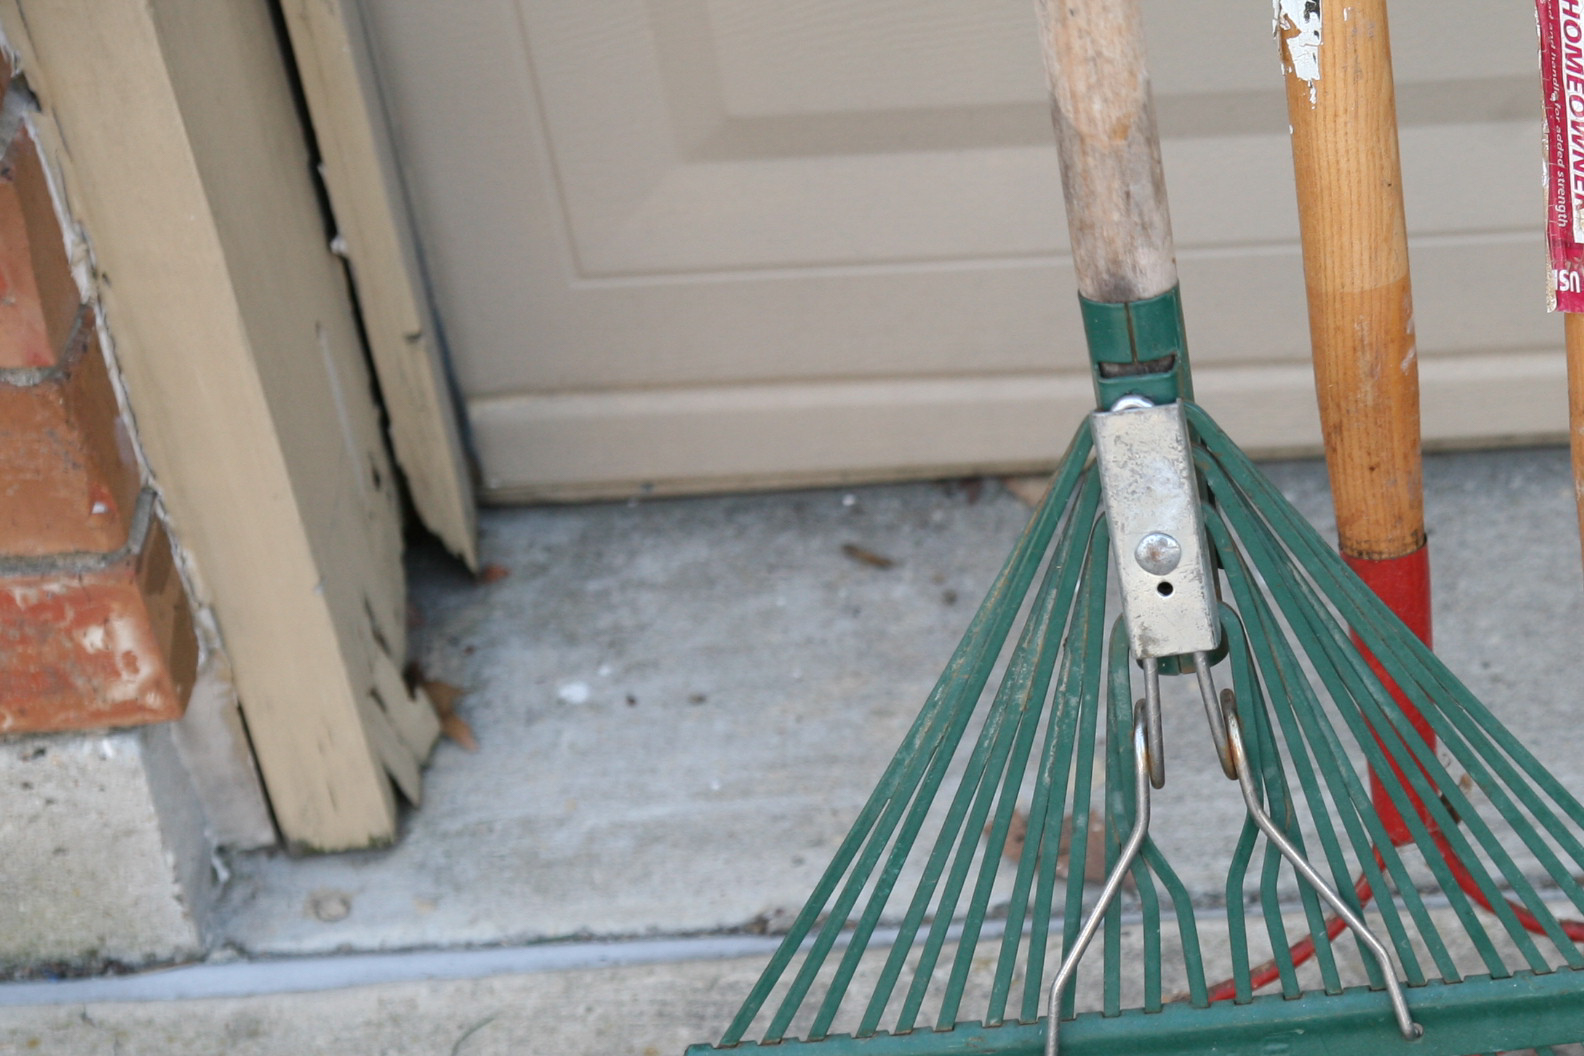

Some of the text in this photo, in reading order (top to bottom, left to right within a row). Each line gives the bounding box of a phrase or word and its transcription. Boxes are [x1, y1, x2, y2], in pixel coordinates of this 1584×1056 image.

[1549, 23, 1557, 49] and
[1553, 103, 1562, 122] for
[1556, 125, 1565, 168] added
[1555, 171, 1568, 227] strength
